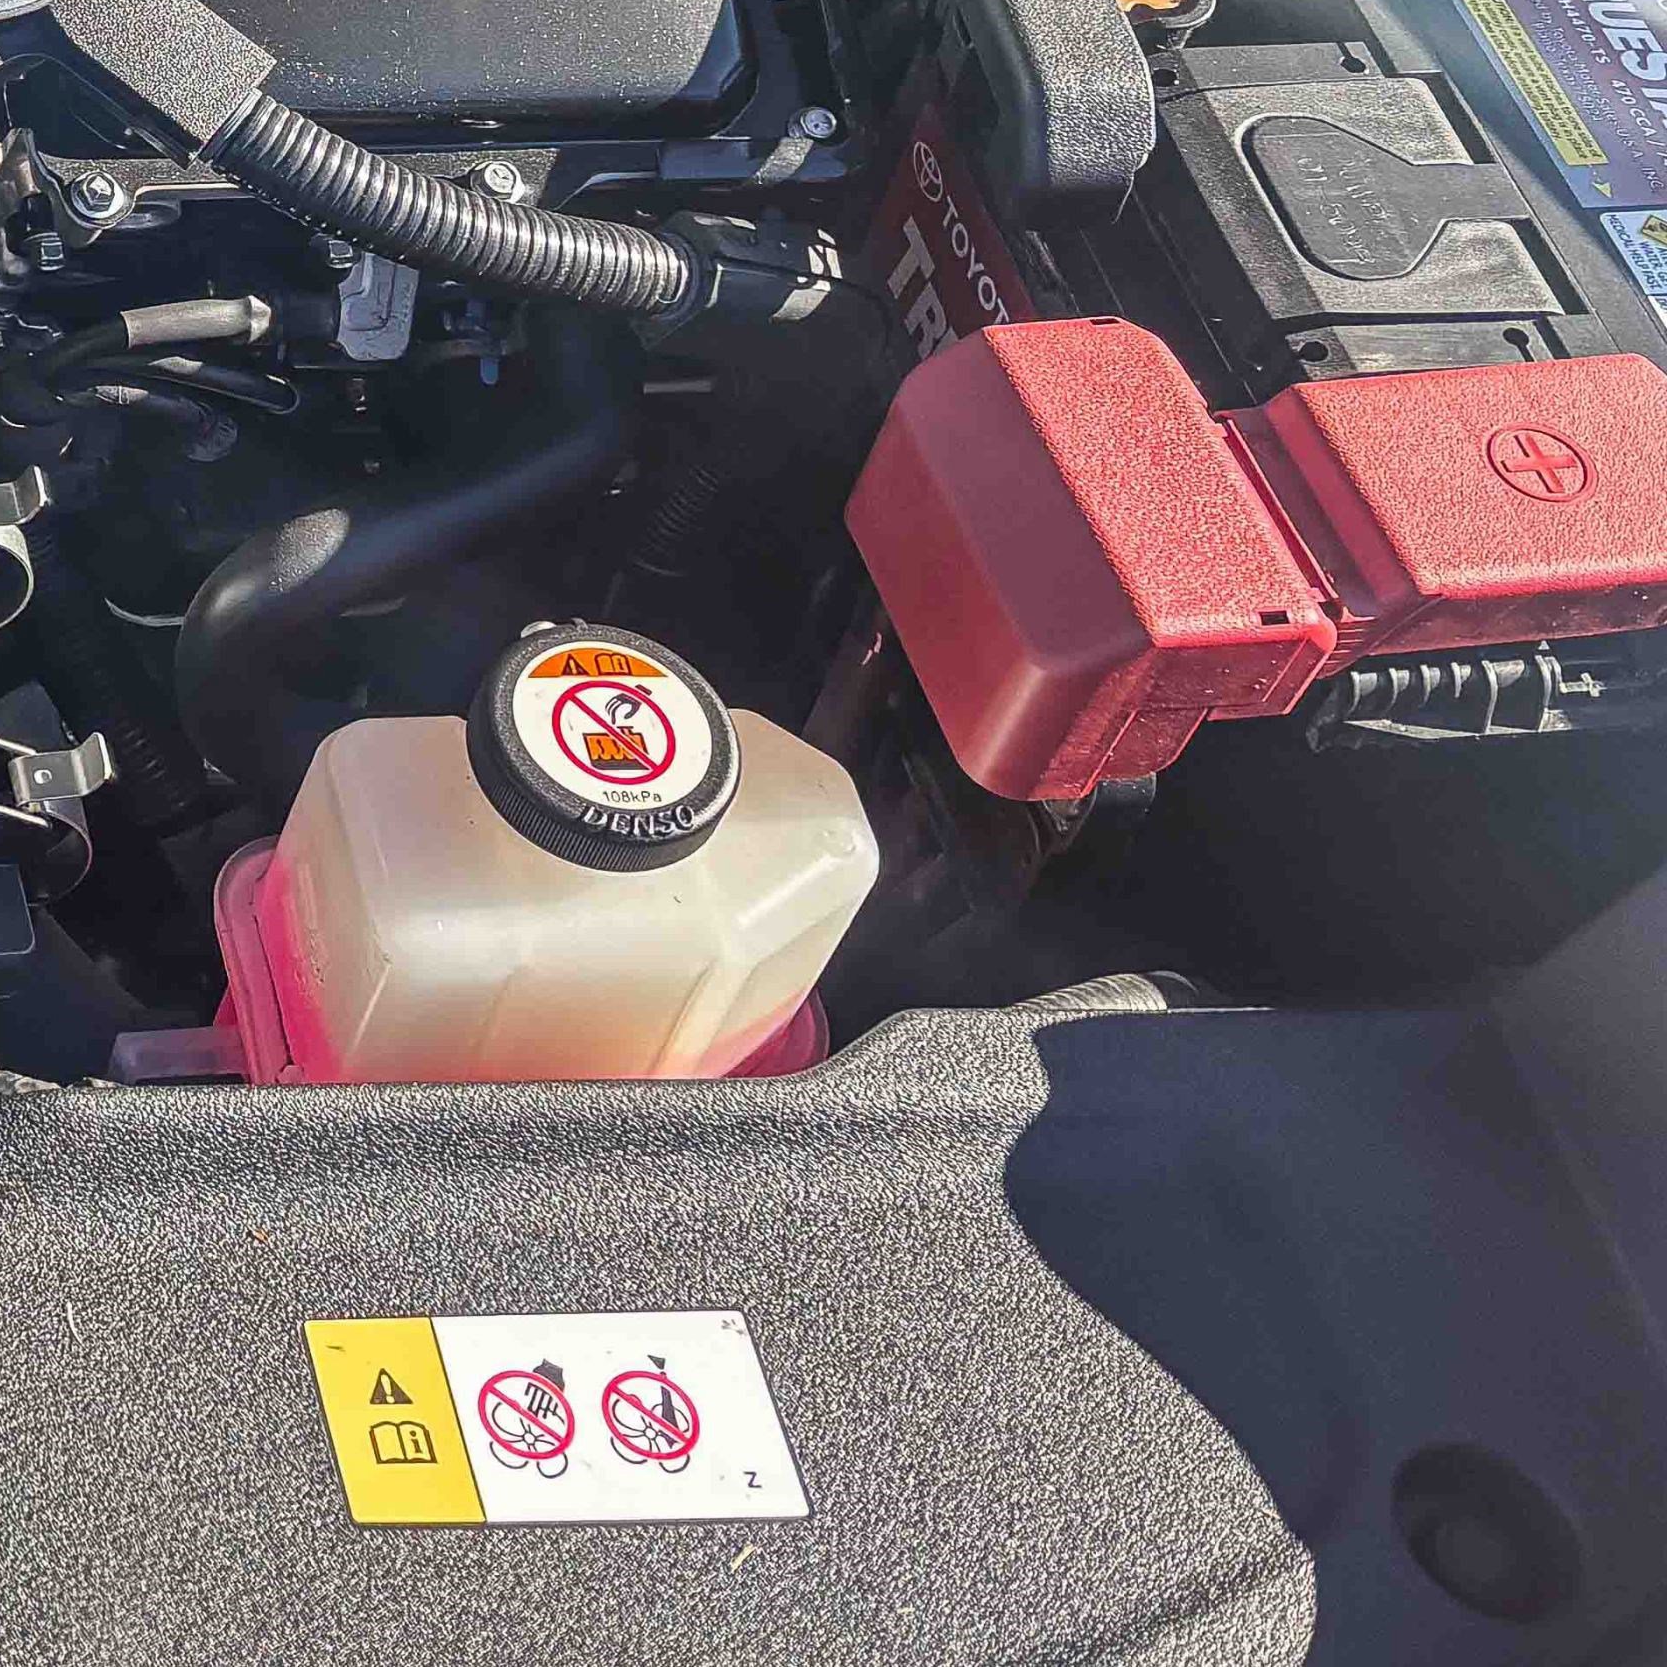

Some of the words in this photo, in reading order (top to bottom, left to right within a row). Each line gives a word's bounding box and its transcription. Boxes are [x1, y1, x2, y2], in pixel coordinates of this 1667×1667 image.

[1612, 79, 1637, 105] 470
[1630, 107, 1657, 137] CCA
[942, 195, 1012, 325] TOYOT
[1609, 214, 1635, 248] MEDICAL
[1628, 249, 1649, 272] HELP
[886, 214, 961, 358] TR
[581, 804, 696, 837] DENSO
[602, 790, 663, 804] 108kPa
